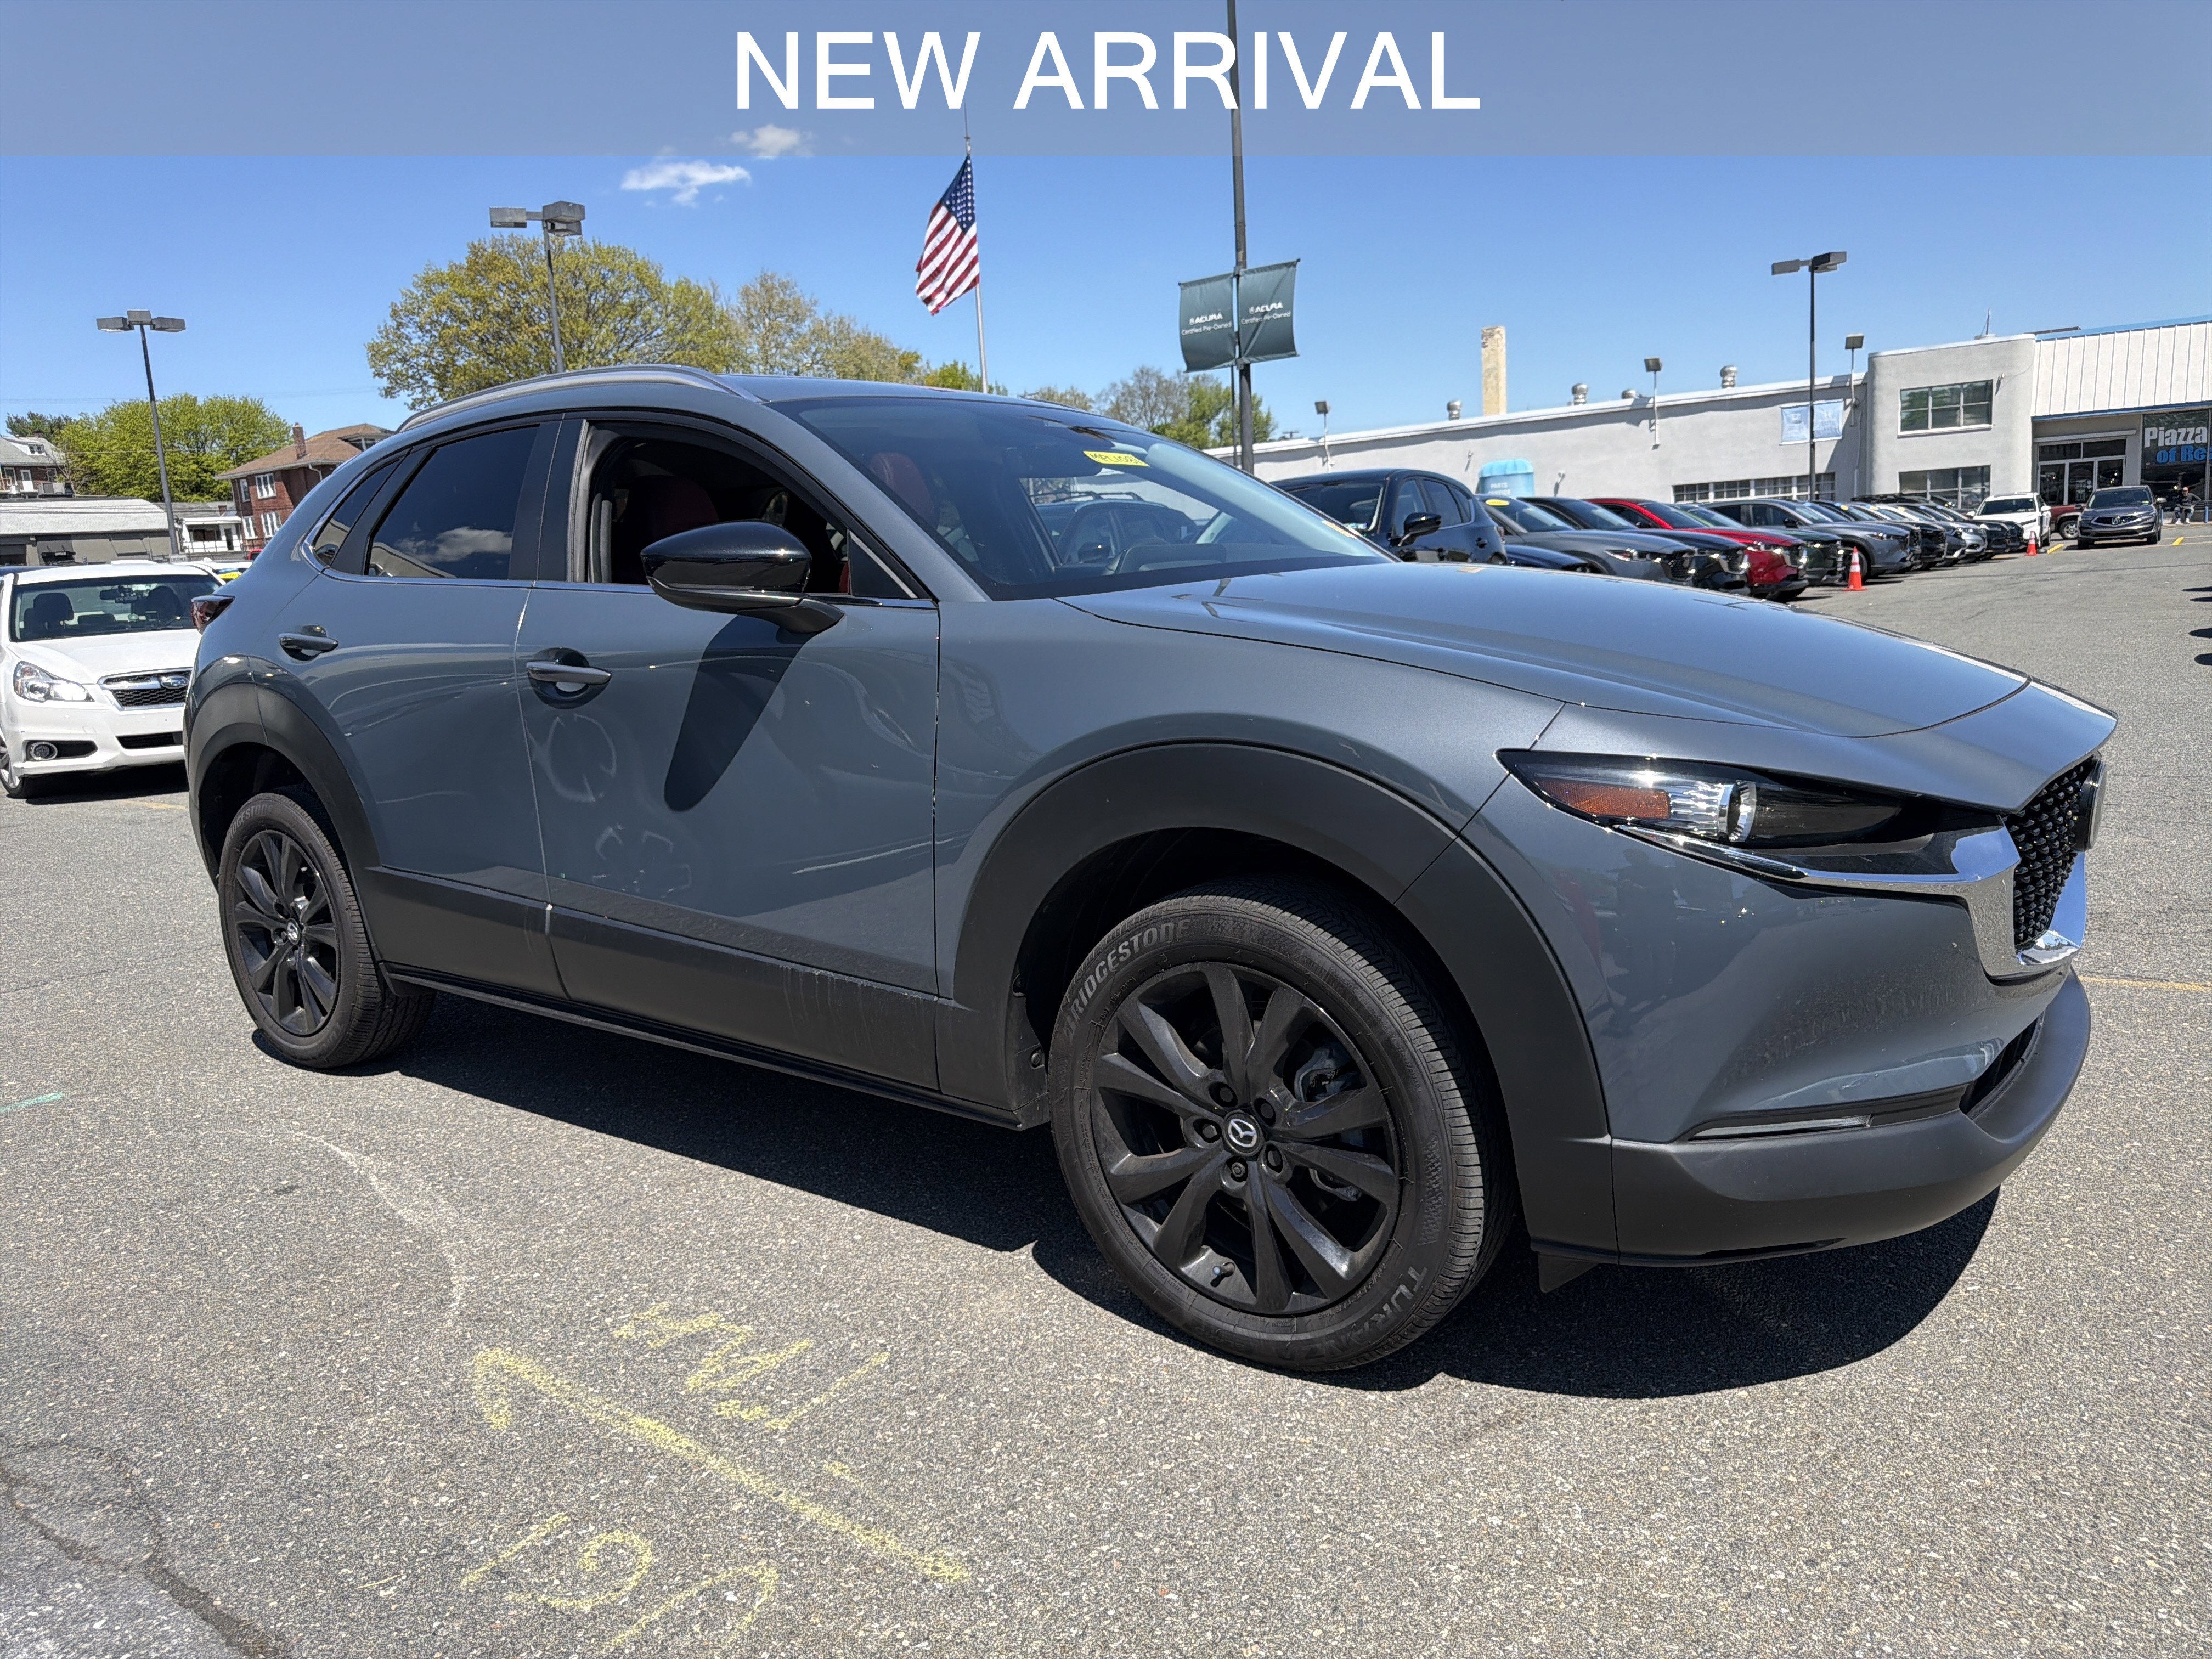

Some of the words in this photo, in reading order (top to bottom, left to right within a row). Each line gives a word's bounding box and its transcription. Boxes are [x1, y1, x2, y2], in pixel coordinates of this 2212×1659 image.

[1254, 302, 1283, 313] ACURA
[1194, 313, 1223, 324] ACURA
[1181, 326, 1203, 335] Certified
[1203, 321, 1232, 331] Pre-Owned
[2144, 426, 2208, 448] Piazza
[2157, 447, 2177, 464] of
[1063, 918, 1192, 1037] BRIDGESTONE
